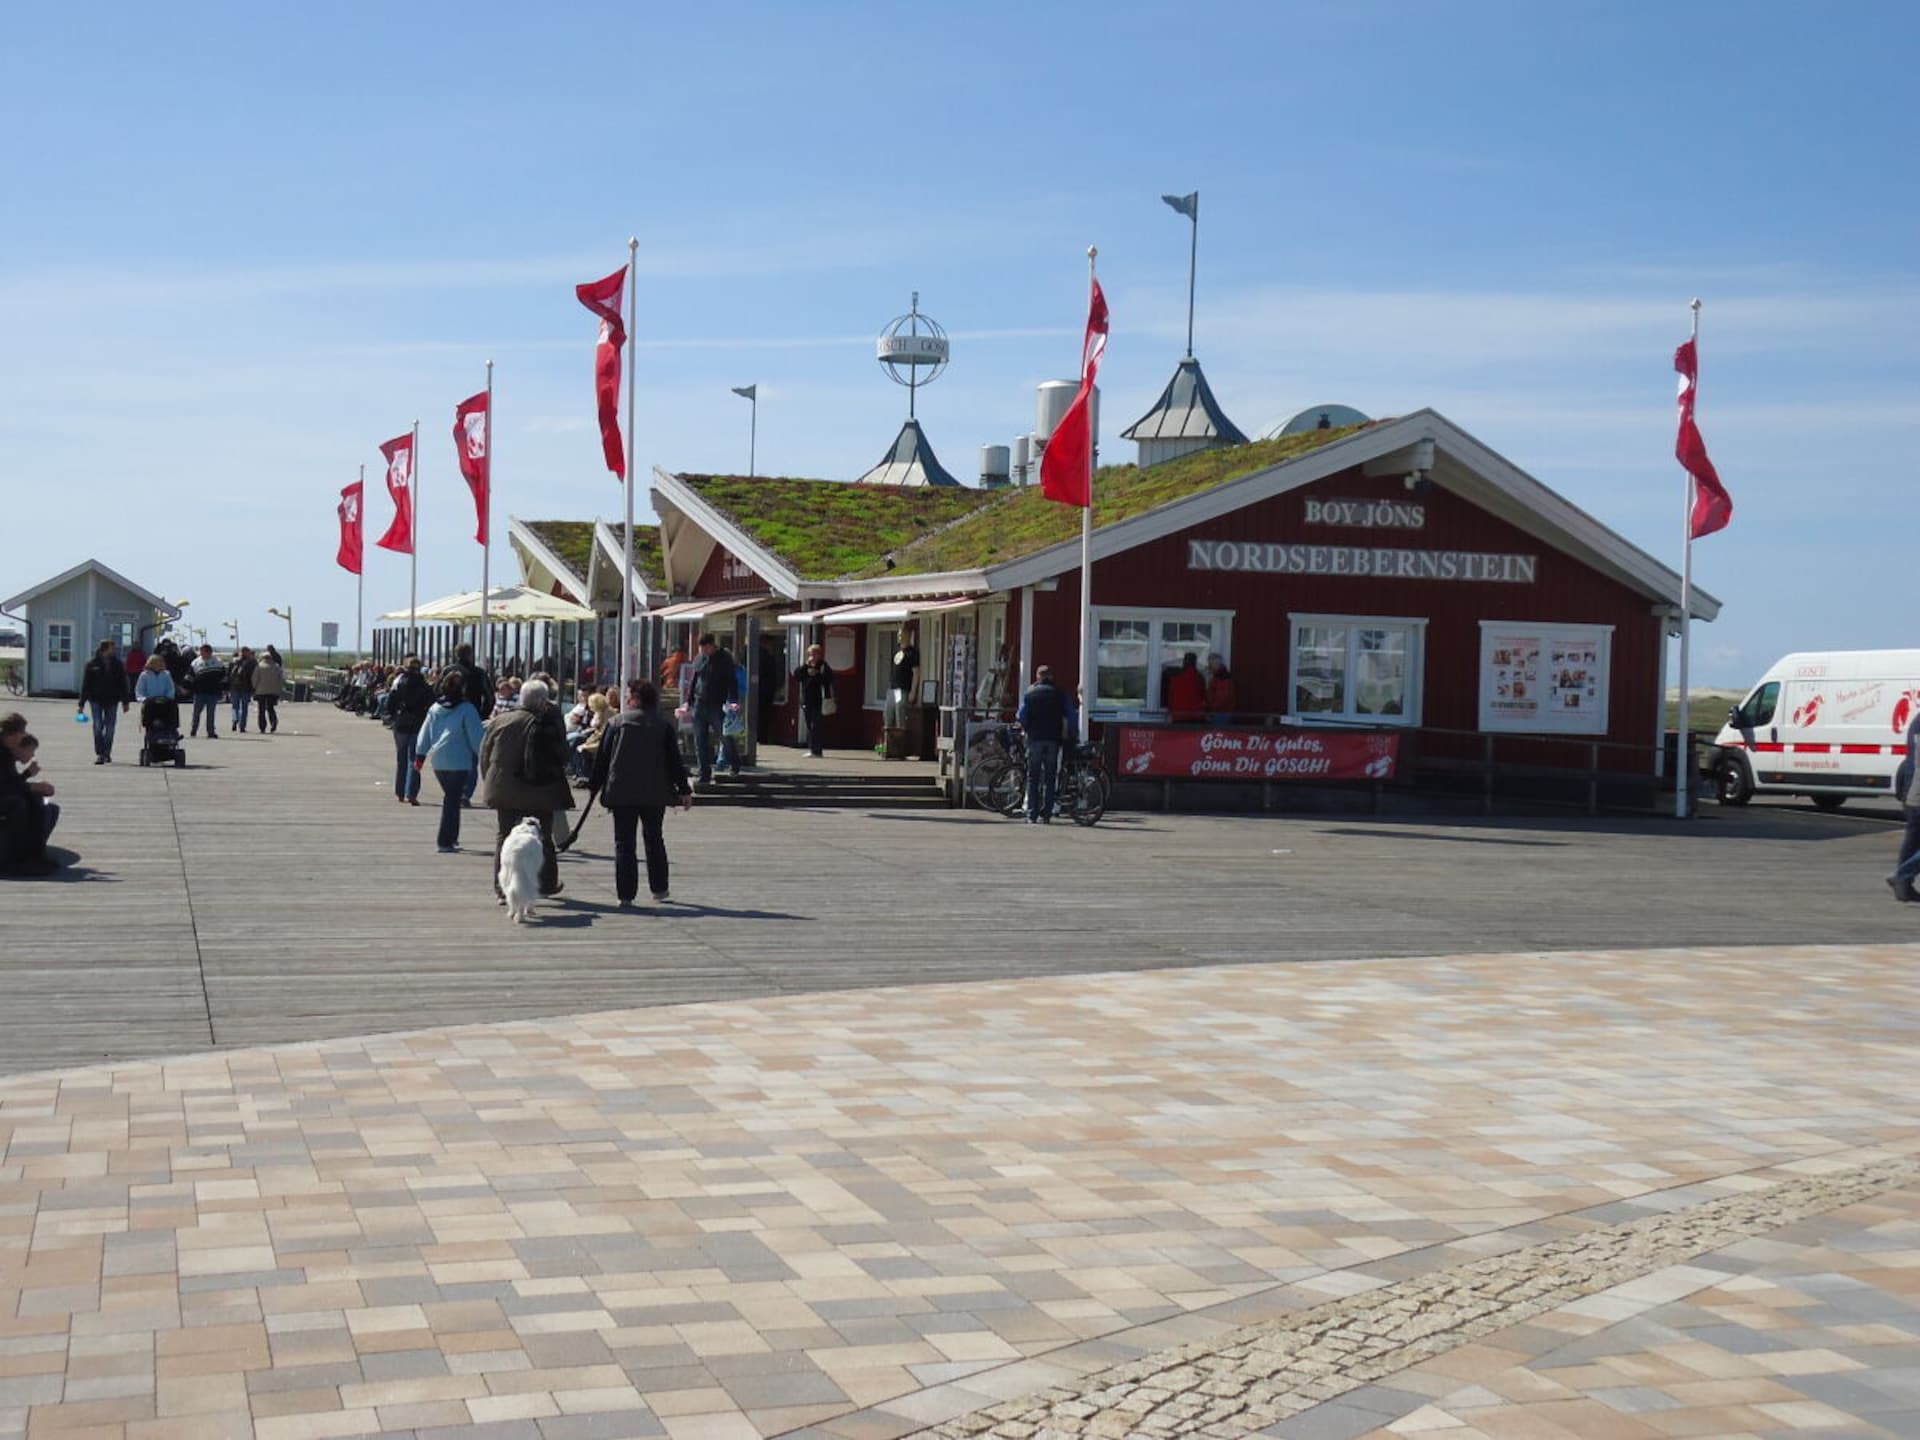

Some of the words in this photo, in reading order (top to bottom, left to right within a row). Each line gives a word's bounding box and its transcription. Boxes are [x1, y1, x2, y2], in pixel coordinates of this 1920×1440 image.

[1304, 501, 1354, 525] BOY
[1362, 500, 1425, 527] JÖNS
[1187, 540, 1536, 582] NORDSEEBERNSTEIN
[1200, 733, 1242, 753] Gönn
[1247, 735, 1270, 752] Dir
[1275, 736, 1323, 754] Gutes,
[1191, 755, 1231, 774] gönn
[1235, 757, 1260, 773] Dir
[1264, 758, 1330, 774] GOSCH!
